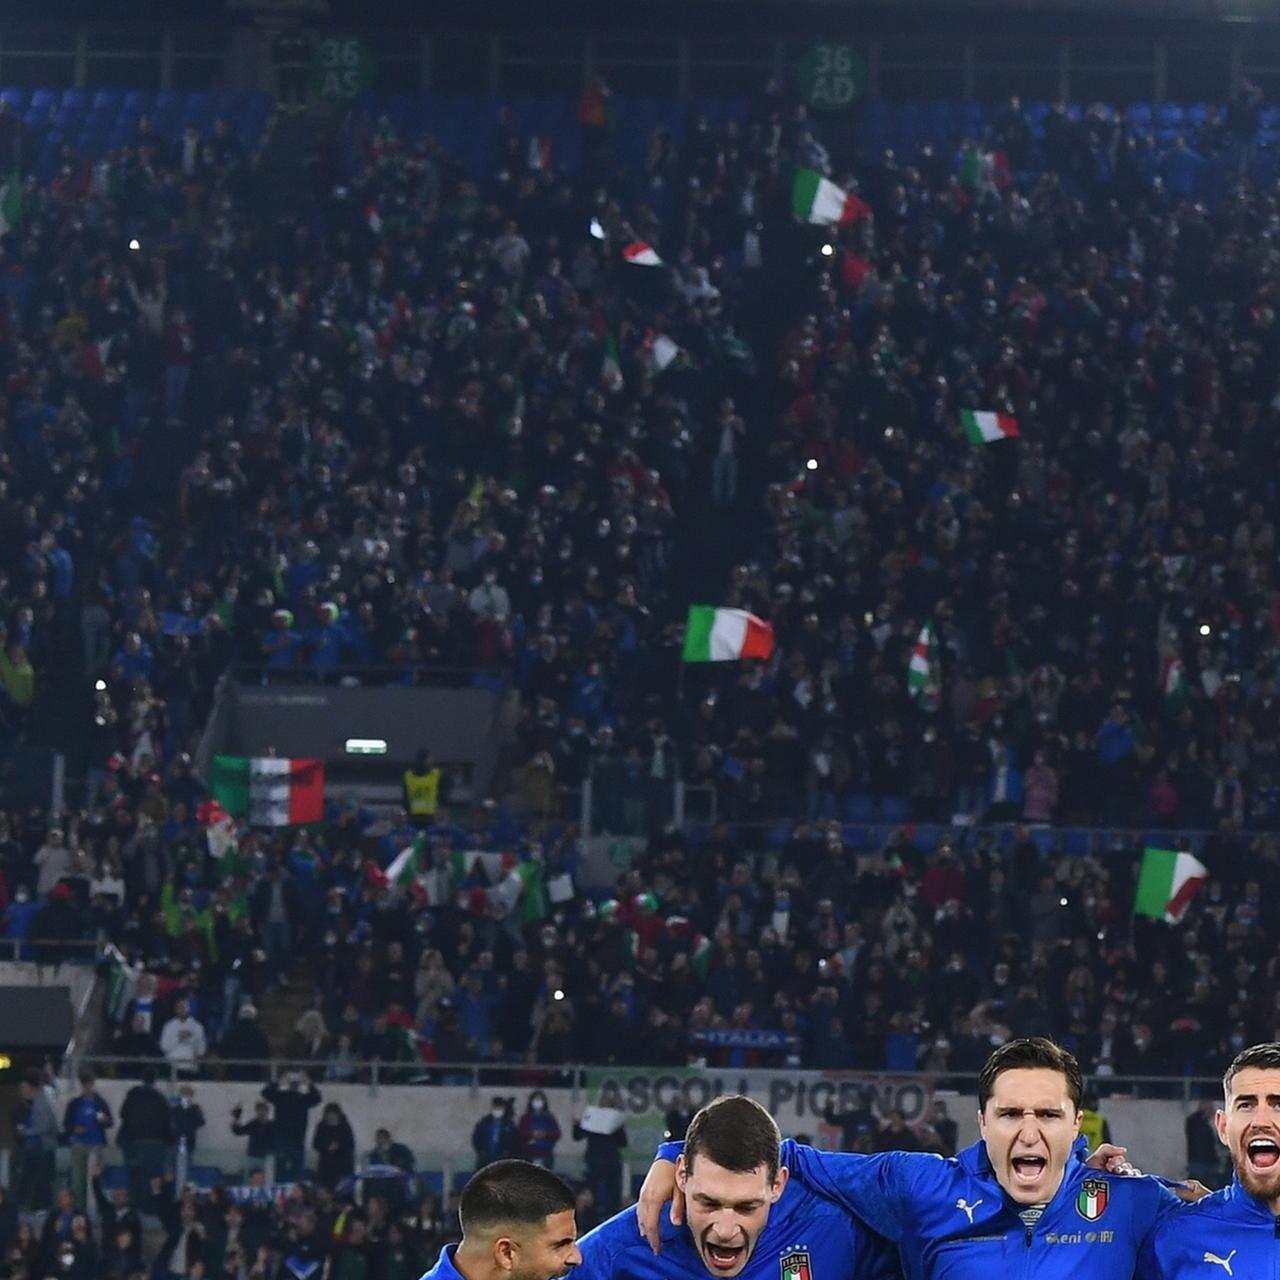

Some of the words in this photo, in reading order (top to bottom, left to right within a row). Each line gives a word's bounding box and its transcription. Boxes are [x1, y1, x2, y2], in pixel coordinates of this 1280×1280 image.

[320, 39, 361, 68] 36
[815, 45, 852, 74] 36
[320, 71, 361, 98] AS
[810, 76, 857, 104] AD
[598, 1076, 748, 1114] ASCO
[1060, 1231, 1081, 1243] eni
[783, 1255, 808, 1266] ITALIA
